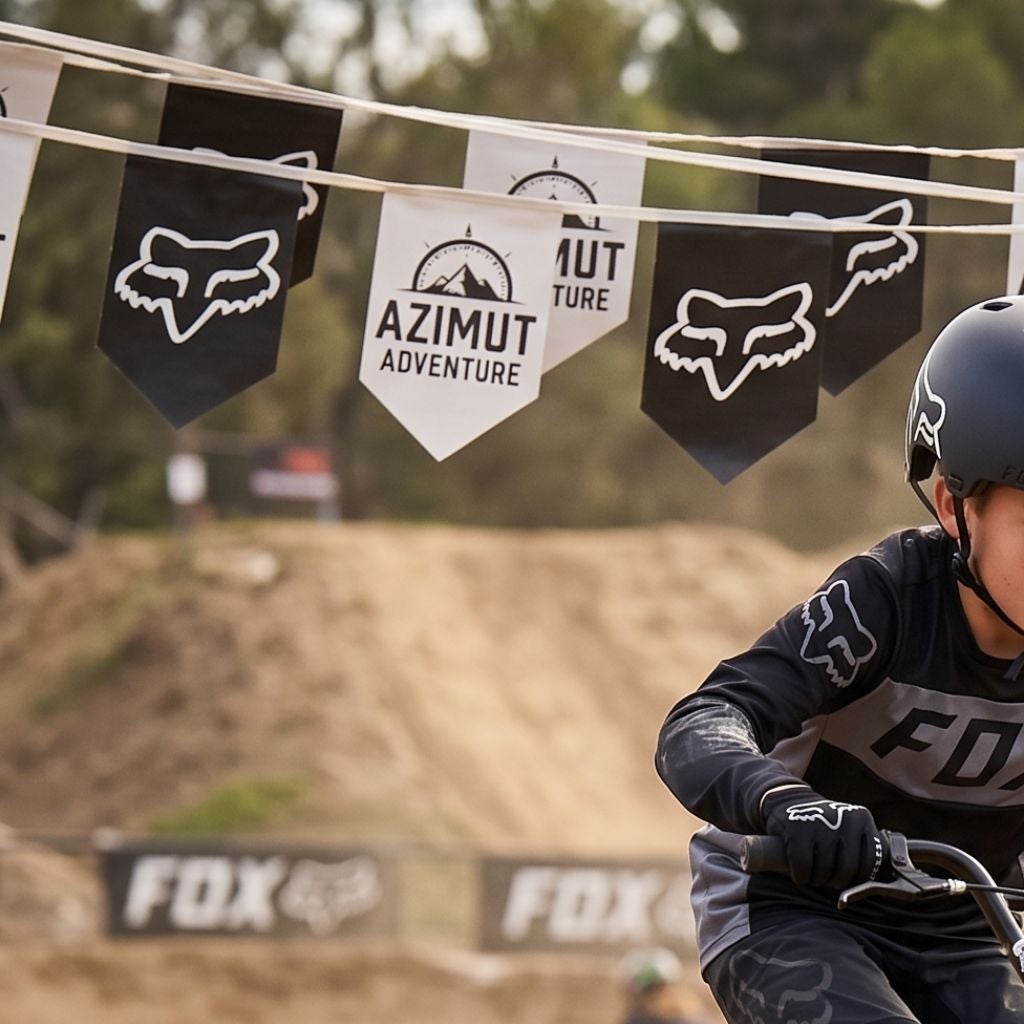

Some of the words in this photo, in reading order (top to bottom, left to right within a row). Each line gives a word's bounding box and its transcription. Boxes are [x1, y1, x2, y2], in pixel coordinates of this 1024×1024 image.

[555, 238, 625, 281] MUT
[375, 300, 537, 355] AZIMUT
[380, 348, 521, 386] ADVENTURE
[123, 855, 287, 931] FOX
[502, 868, 665, 942] FOX
